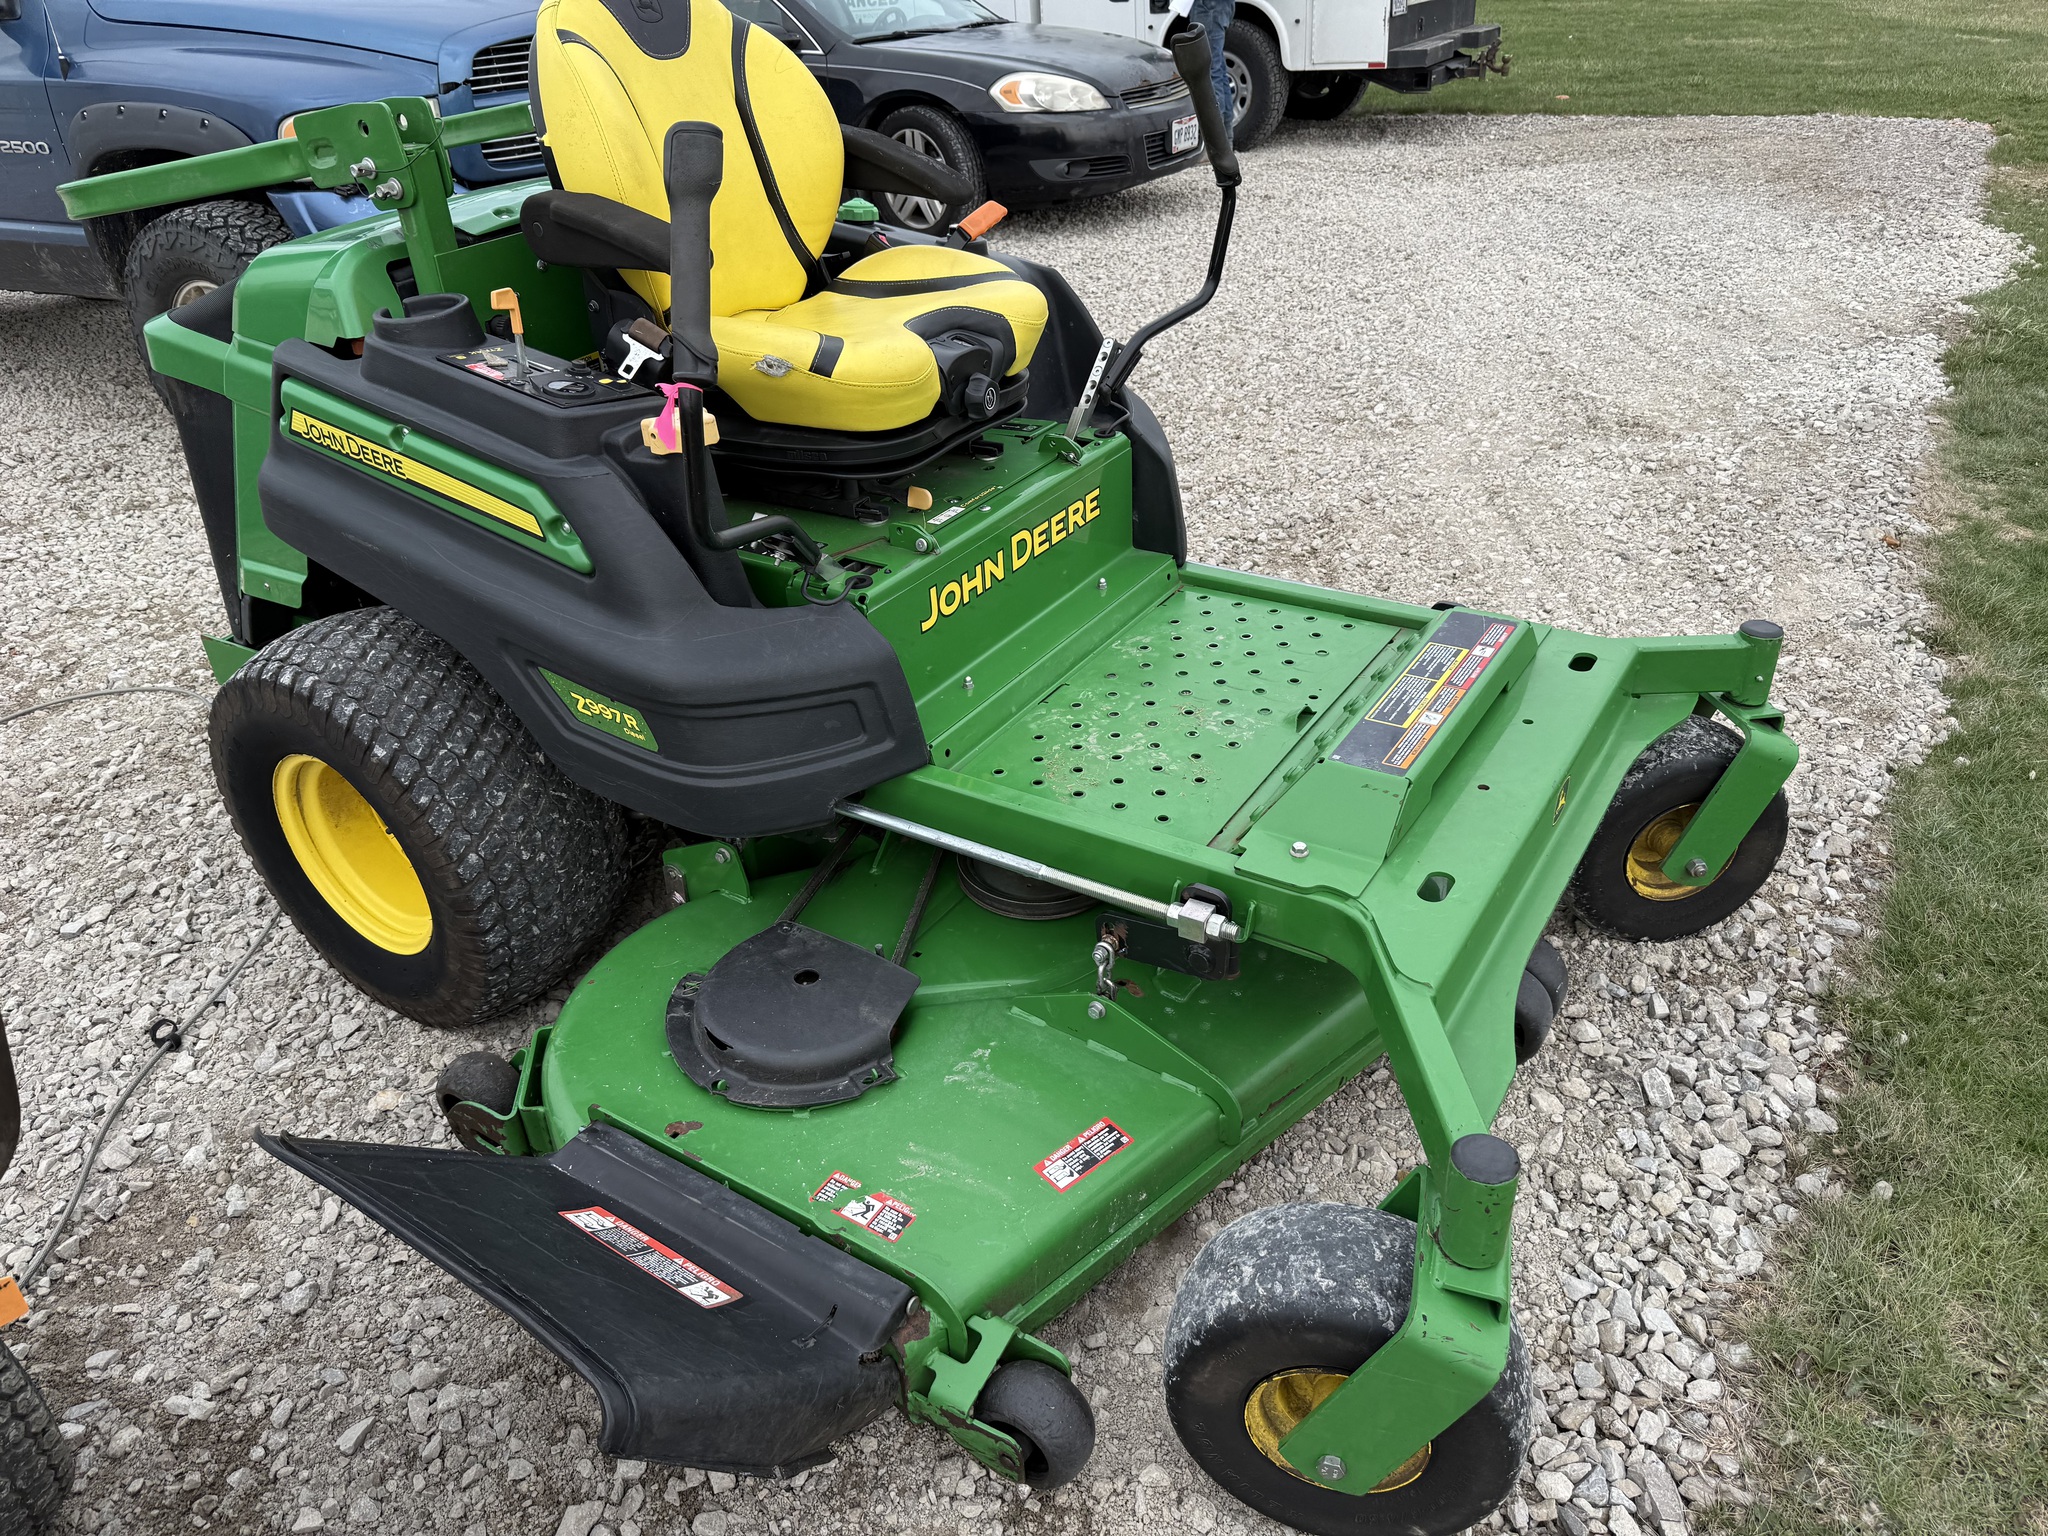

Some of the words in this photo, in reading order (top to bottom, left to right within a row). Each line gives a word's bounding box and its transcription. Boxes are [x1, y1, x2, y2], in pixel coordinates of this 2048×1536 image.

[0, 140, 51, 155] 2500
[302, 418, 345, 454] JOHN
[347, 434, 407, 478] DEERE
[921, 548, 1005, 634] JOHN
[1010, 486, 1101, 573] DEERE
[1082, 1121, 1106, 1138] PELIGRO
[1049, 1144, 1073, 1161] DANGER
[615, 1220, 650, 1242] DANGER
[683, 1262, 721, 1287] PELIGRO
